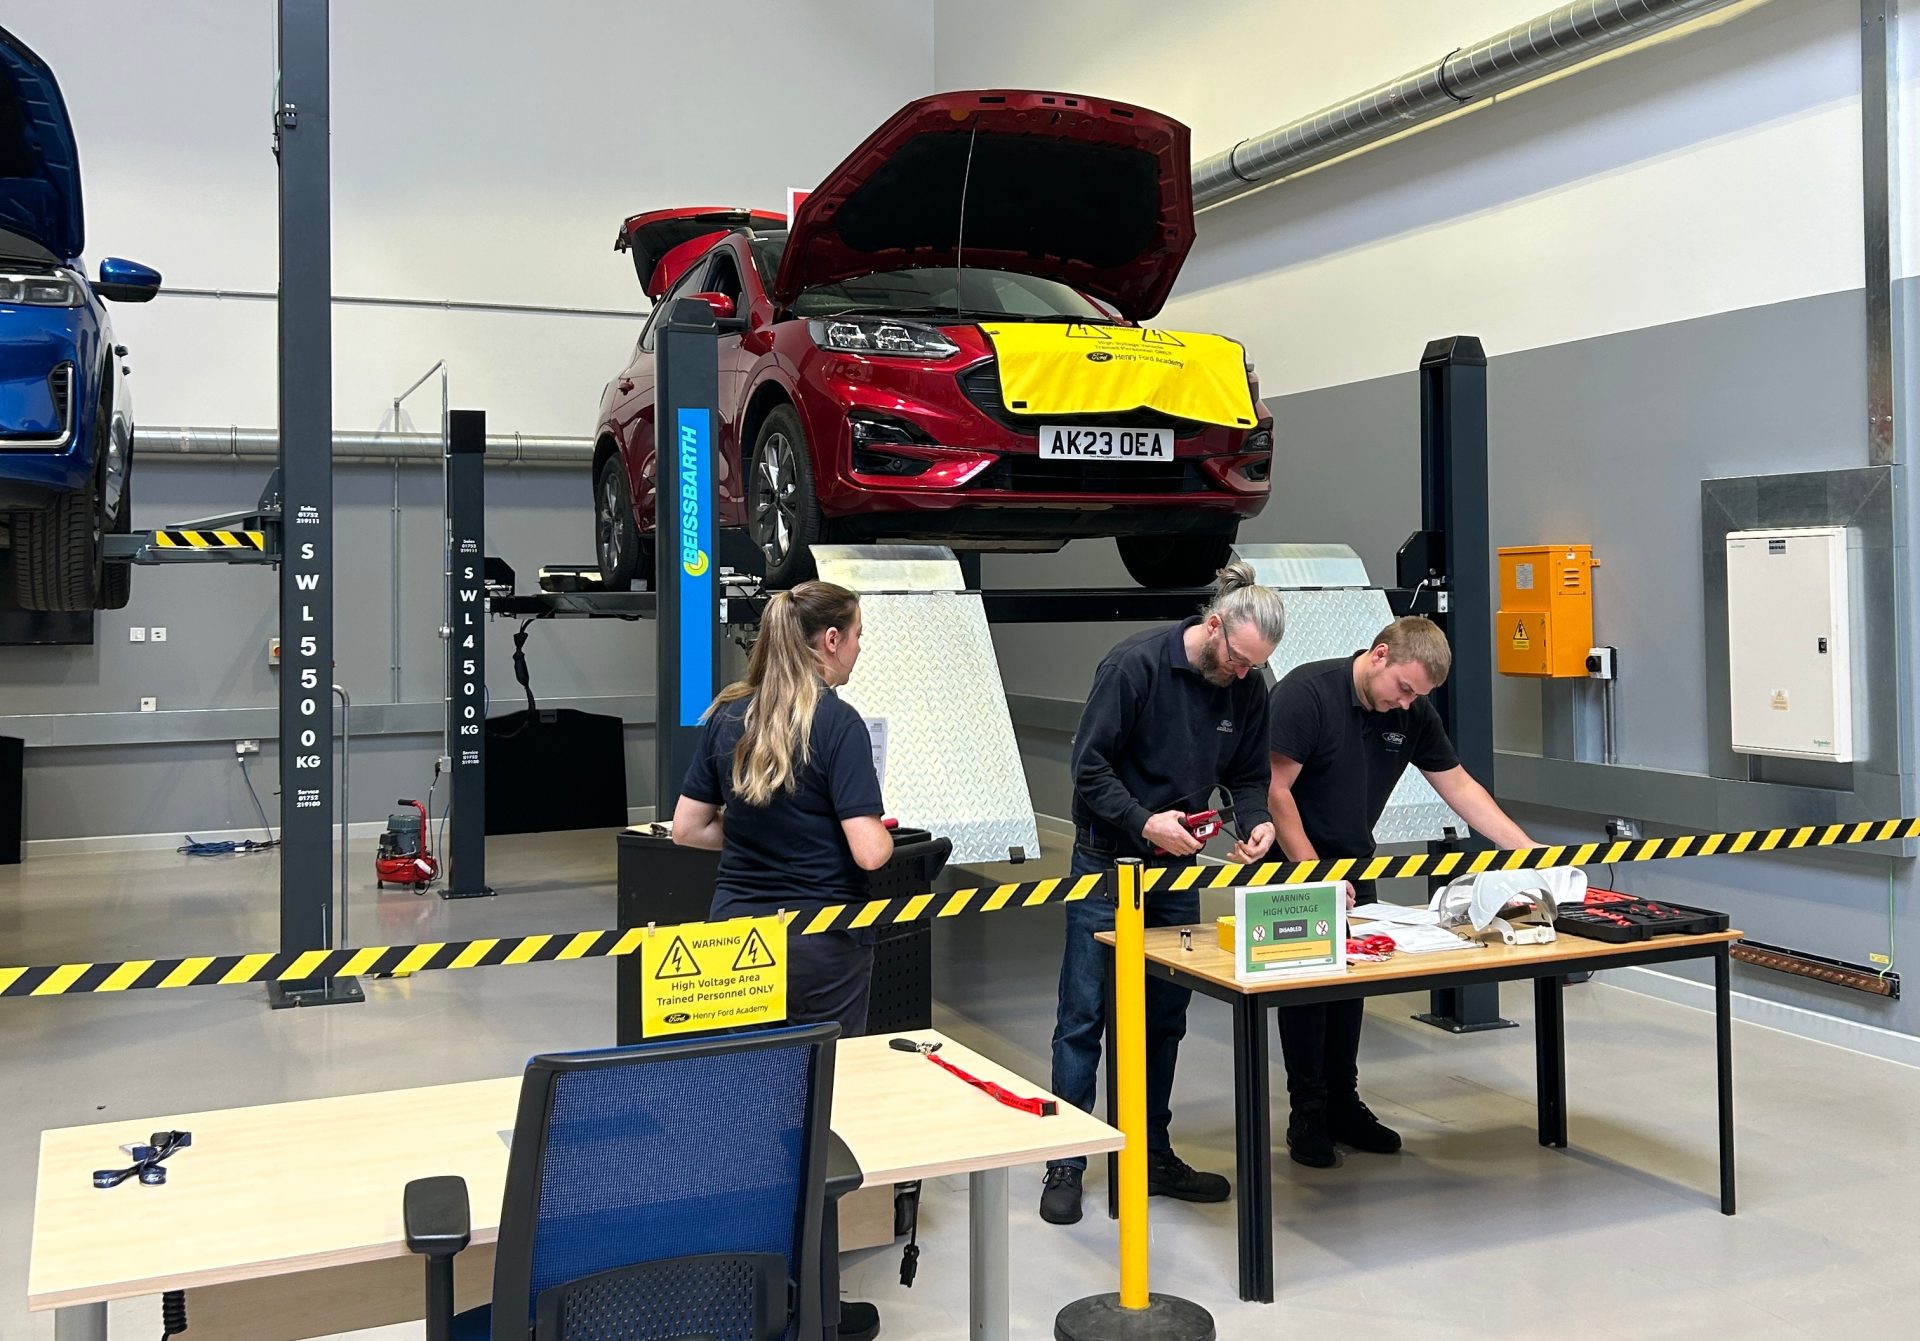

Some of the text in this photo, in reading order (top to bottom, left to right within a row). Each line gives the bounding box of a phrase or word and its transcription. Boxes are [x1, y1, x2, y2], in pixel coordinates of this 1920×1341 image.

[1115, 353, 1184, 369] Henry Ford Academy
[1051, 430, 1163, 457] AK23 OEA
[682, 425, 699, 566] BEISSBARTH
[460, 724, 479, 735] KG
[296, 755, 321, 769] KG
[1271, 893, 1310, 904] WARNING
[1263, 904, 1319, 917] HIGH VOLTAGE
[1278, 926, 1303, 934] DISABLED
[692, 936, 741, 949] WARNING
[671, 973, 760, 992] High Voltage Area
[657, 984, 775, 1007] Trained Personnel ONLY
[692, 1004, 768, 1020] Henry Ford Academy
